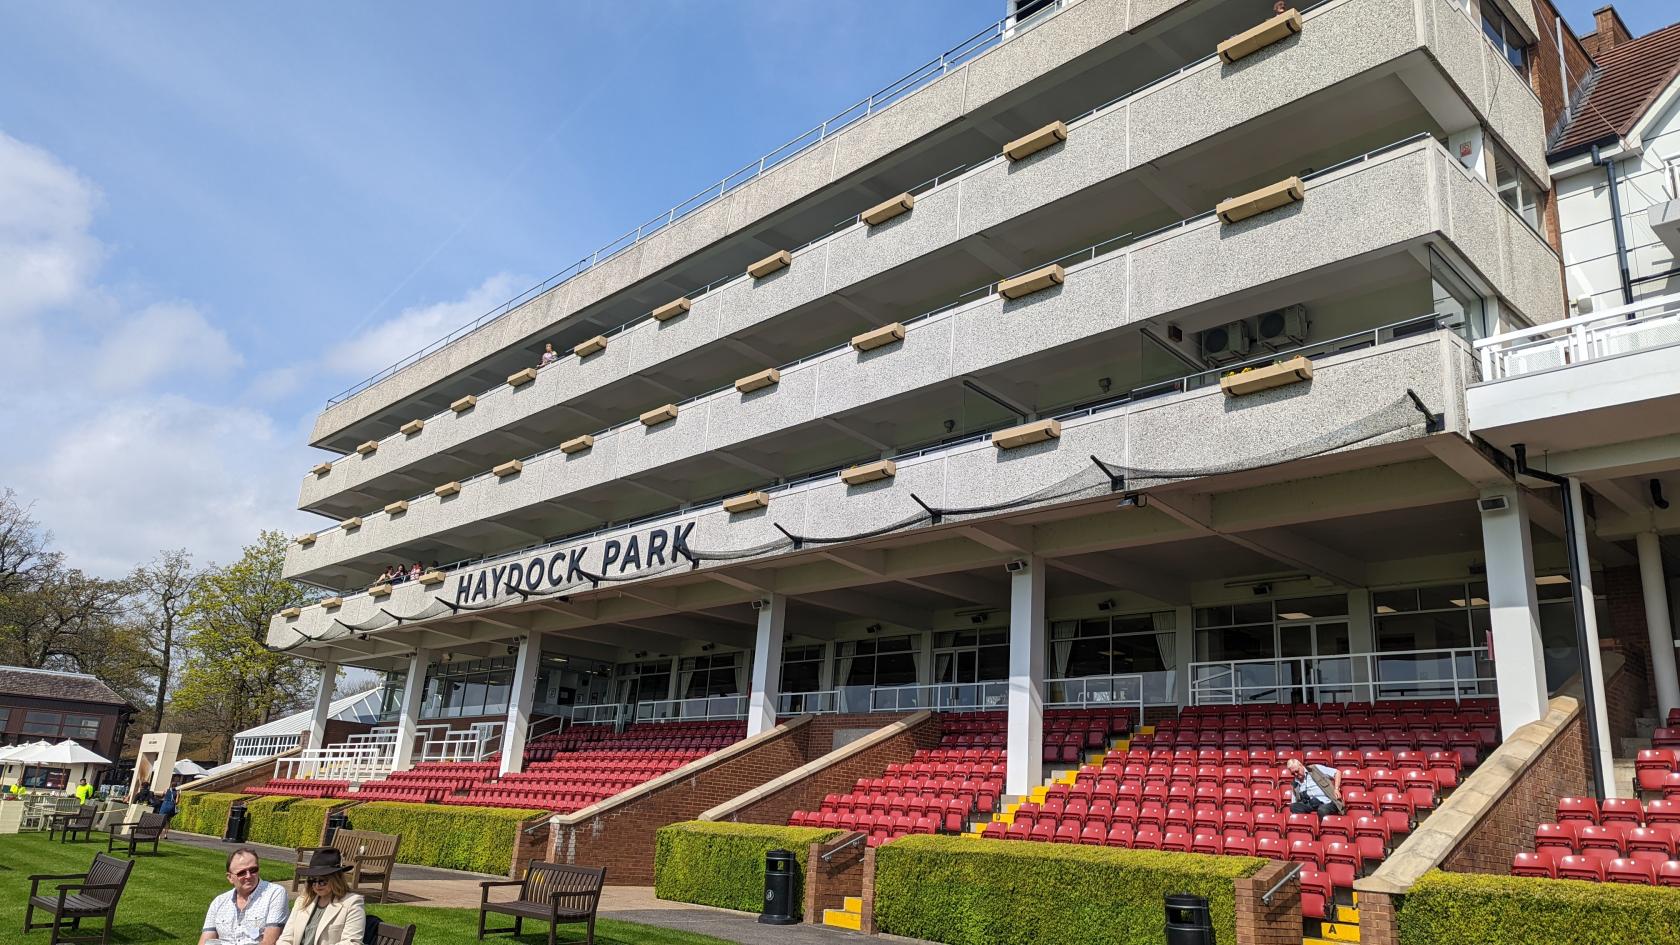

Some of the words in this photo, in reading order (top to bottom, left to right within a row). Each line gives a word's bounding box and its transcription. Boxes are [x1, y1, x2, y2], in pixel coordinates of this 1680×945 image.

[456, 546, 588, 605] HAYDOCK
[601, 521, 696, 576] PARK
[1328, 923, 1337, 935] A
